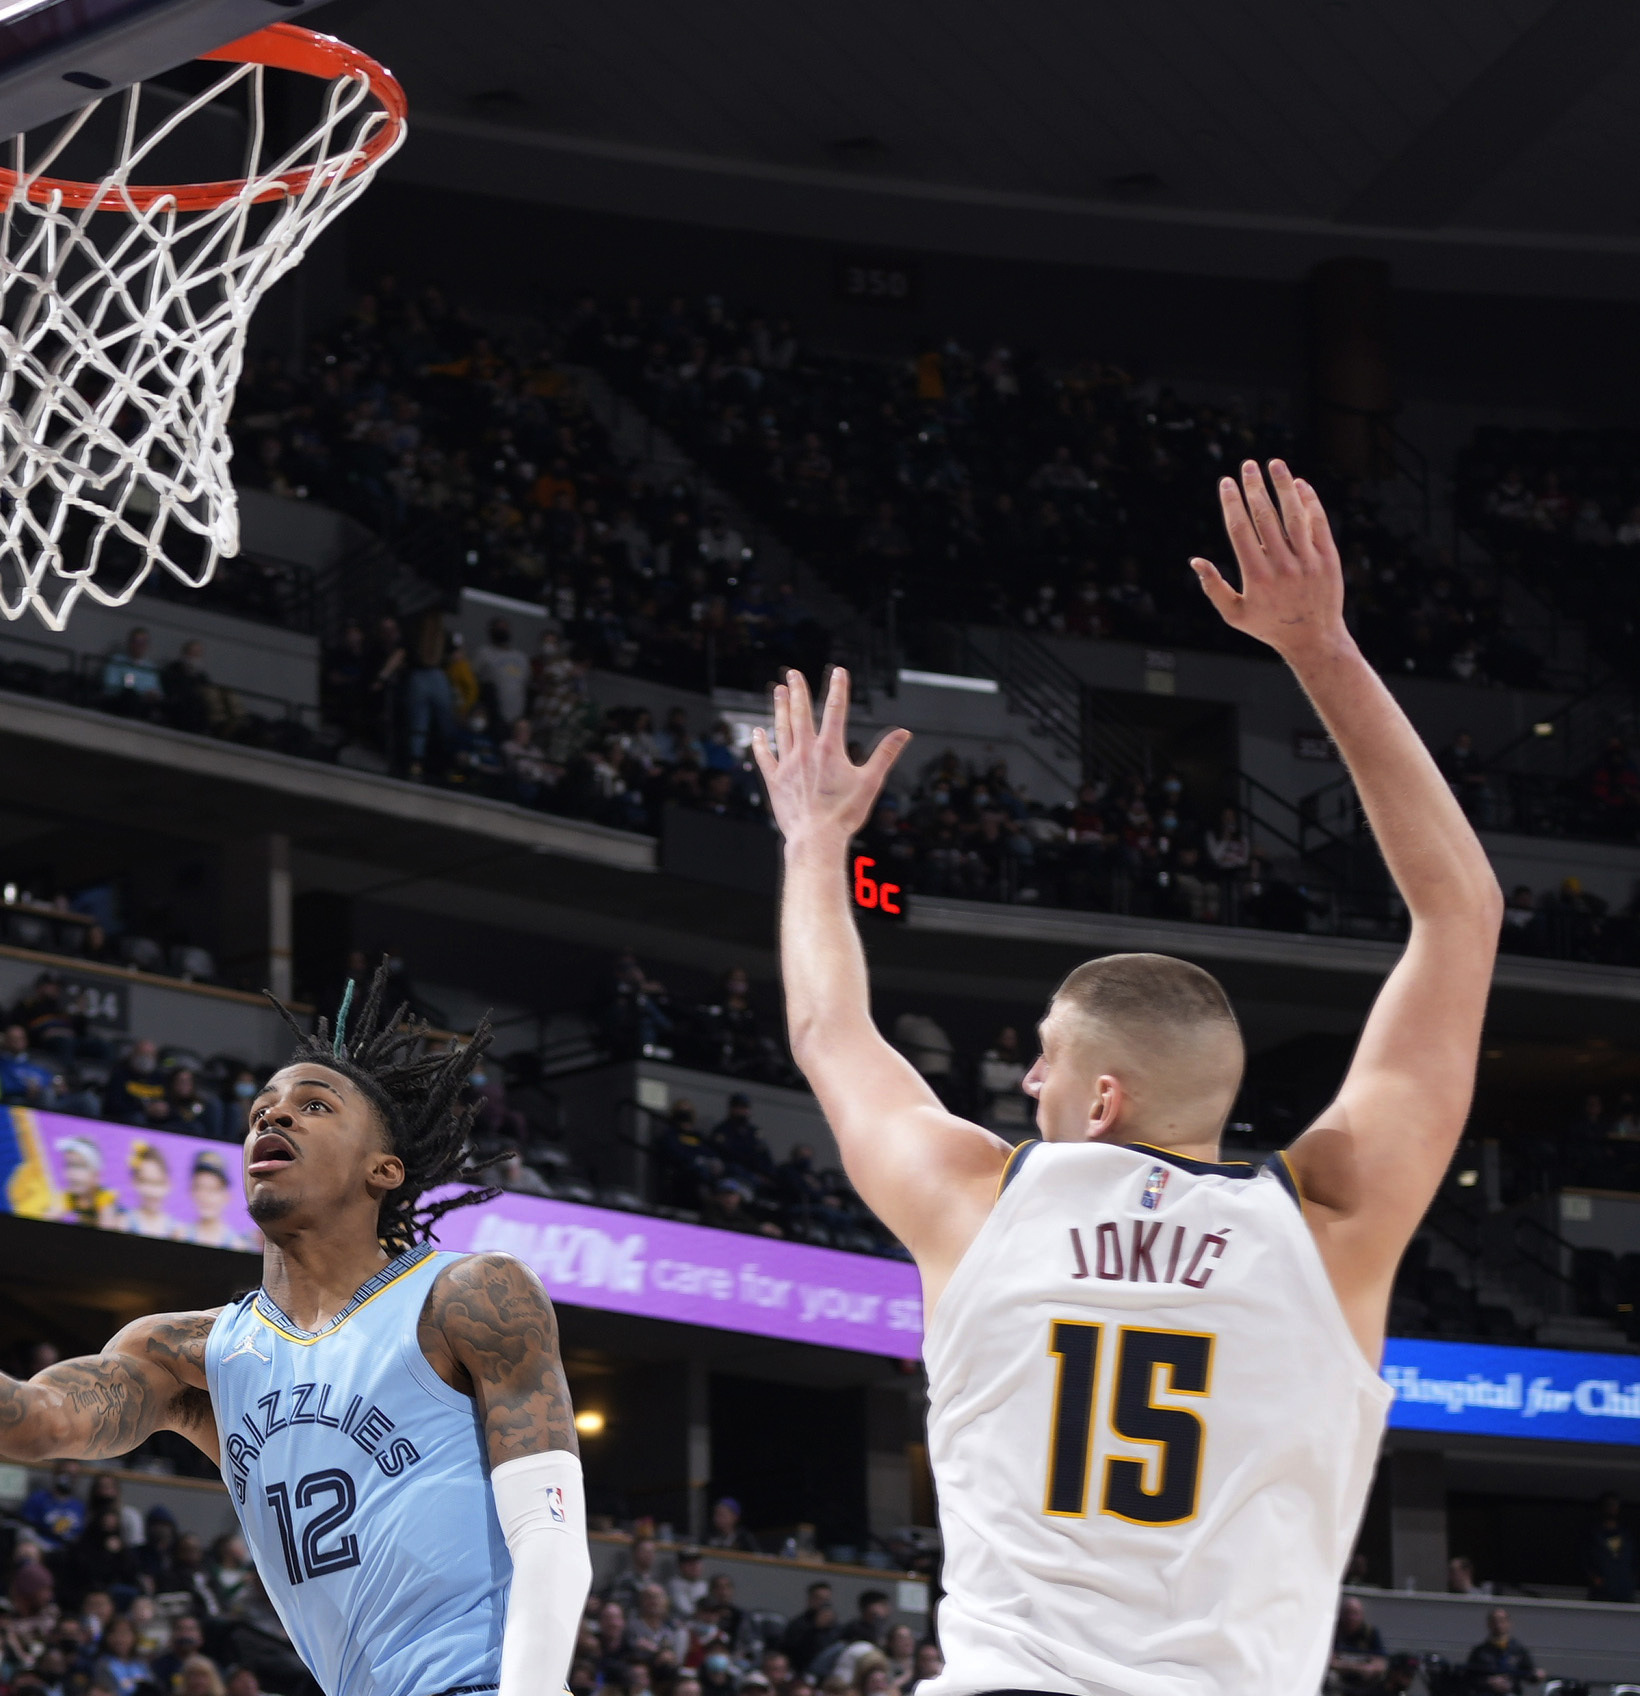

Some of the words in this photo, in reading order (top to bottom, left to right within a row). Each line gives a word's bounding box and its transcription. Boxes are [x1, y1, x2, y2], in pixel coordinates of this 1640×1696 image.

[1069, 1219, 1234, 1290] JOKIĆ
[654, 1258, 734, 1301] care
[738, 1263, 792, 1309] for
[798, 1286, 882, 1324] your
[1042, 1318, 1217, 1528] 15
[1383, 1365, 1523, 1415] Hospital
[1522, 1376, 1574, 1418] for
[266, 1467, 362, 1587] 12
